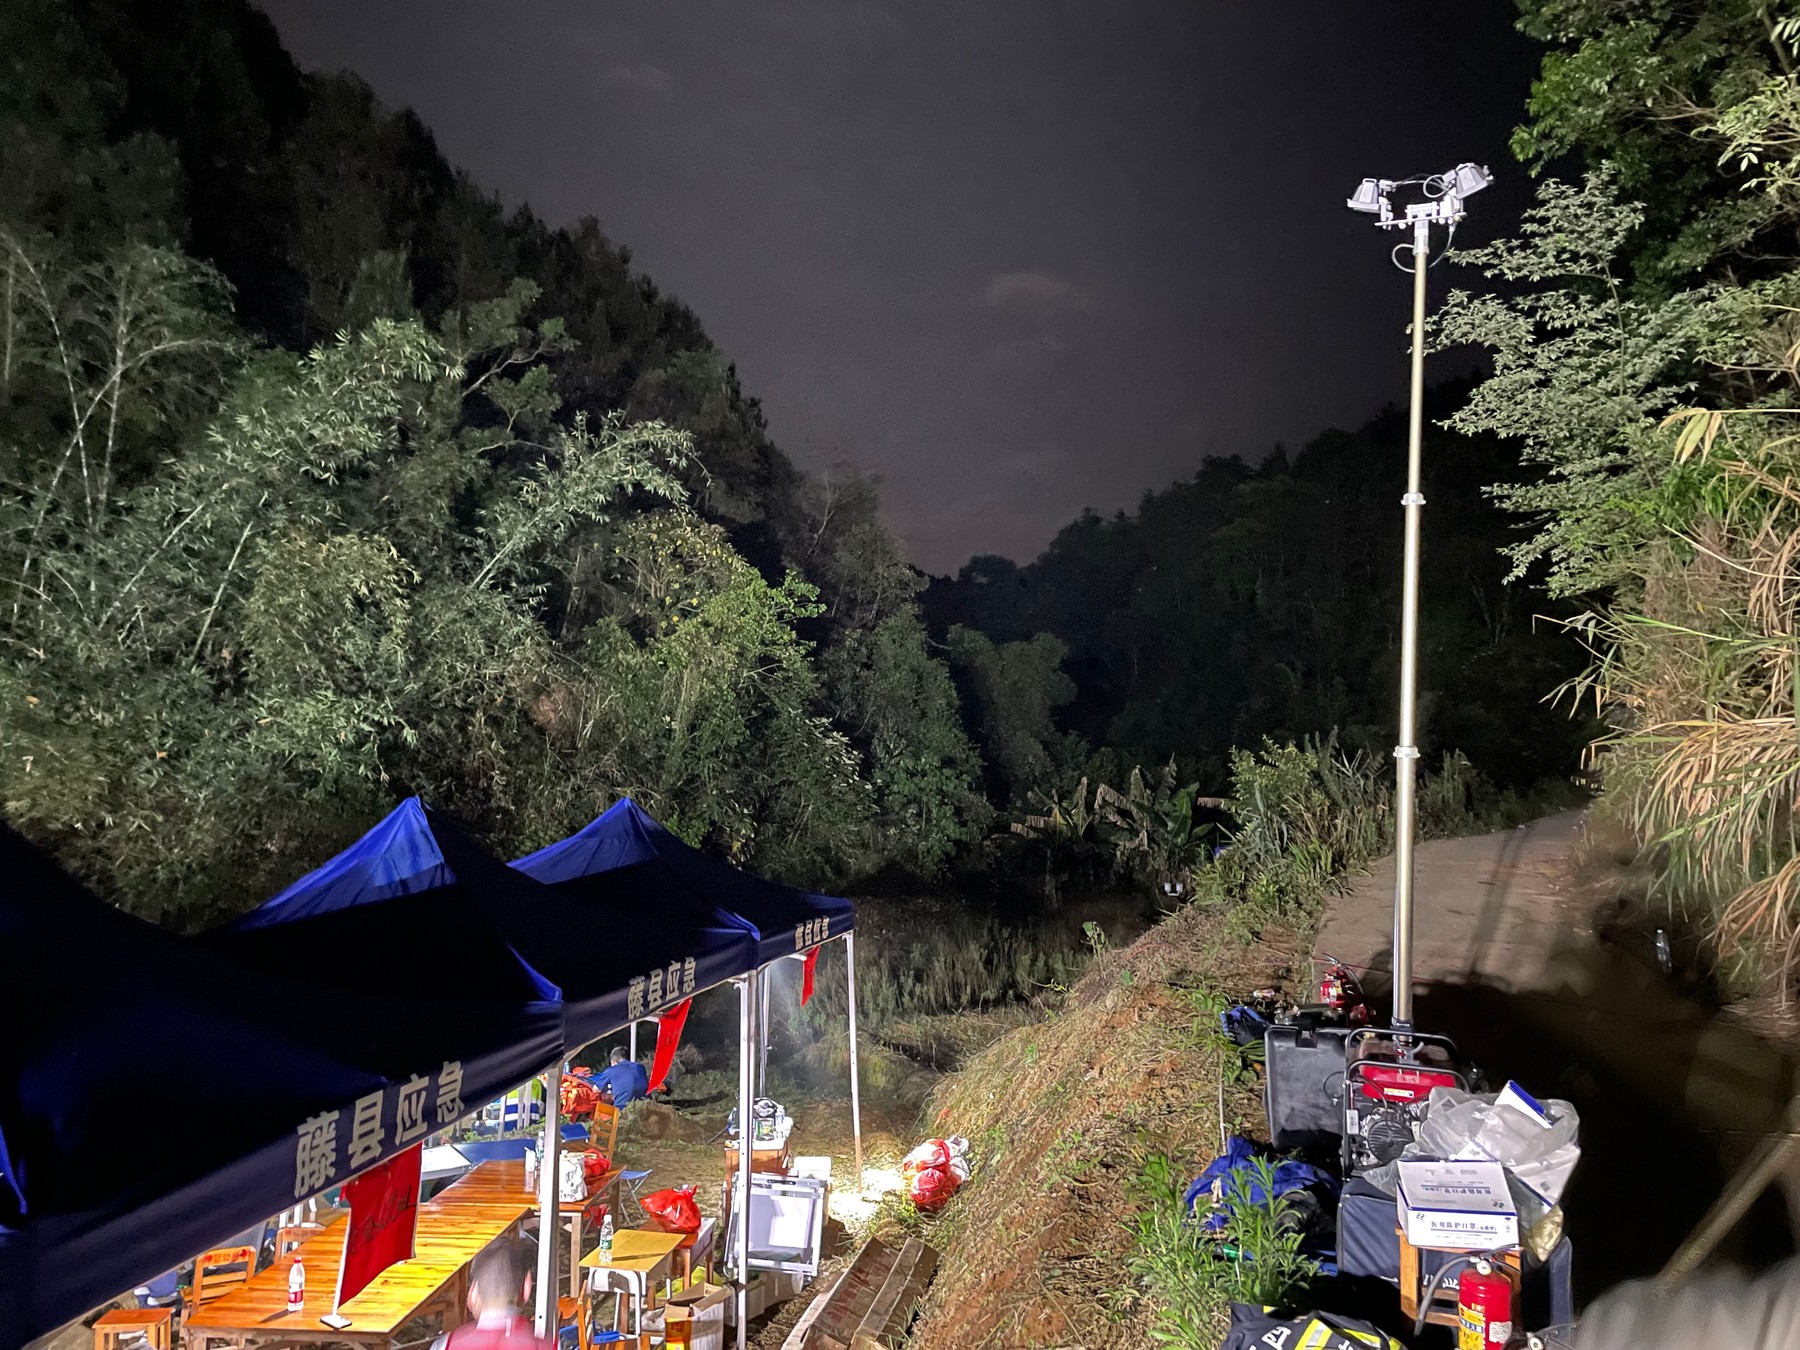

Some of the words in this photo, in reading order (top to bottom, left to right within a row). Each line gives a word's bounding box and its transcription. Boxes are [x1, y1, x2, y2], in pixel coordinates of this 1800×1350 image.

[628, 957, 696, 1020] 藤县应急
[295, 1060, 464, 1198] 藤县应急
